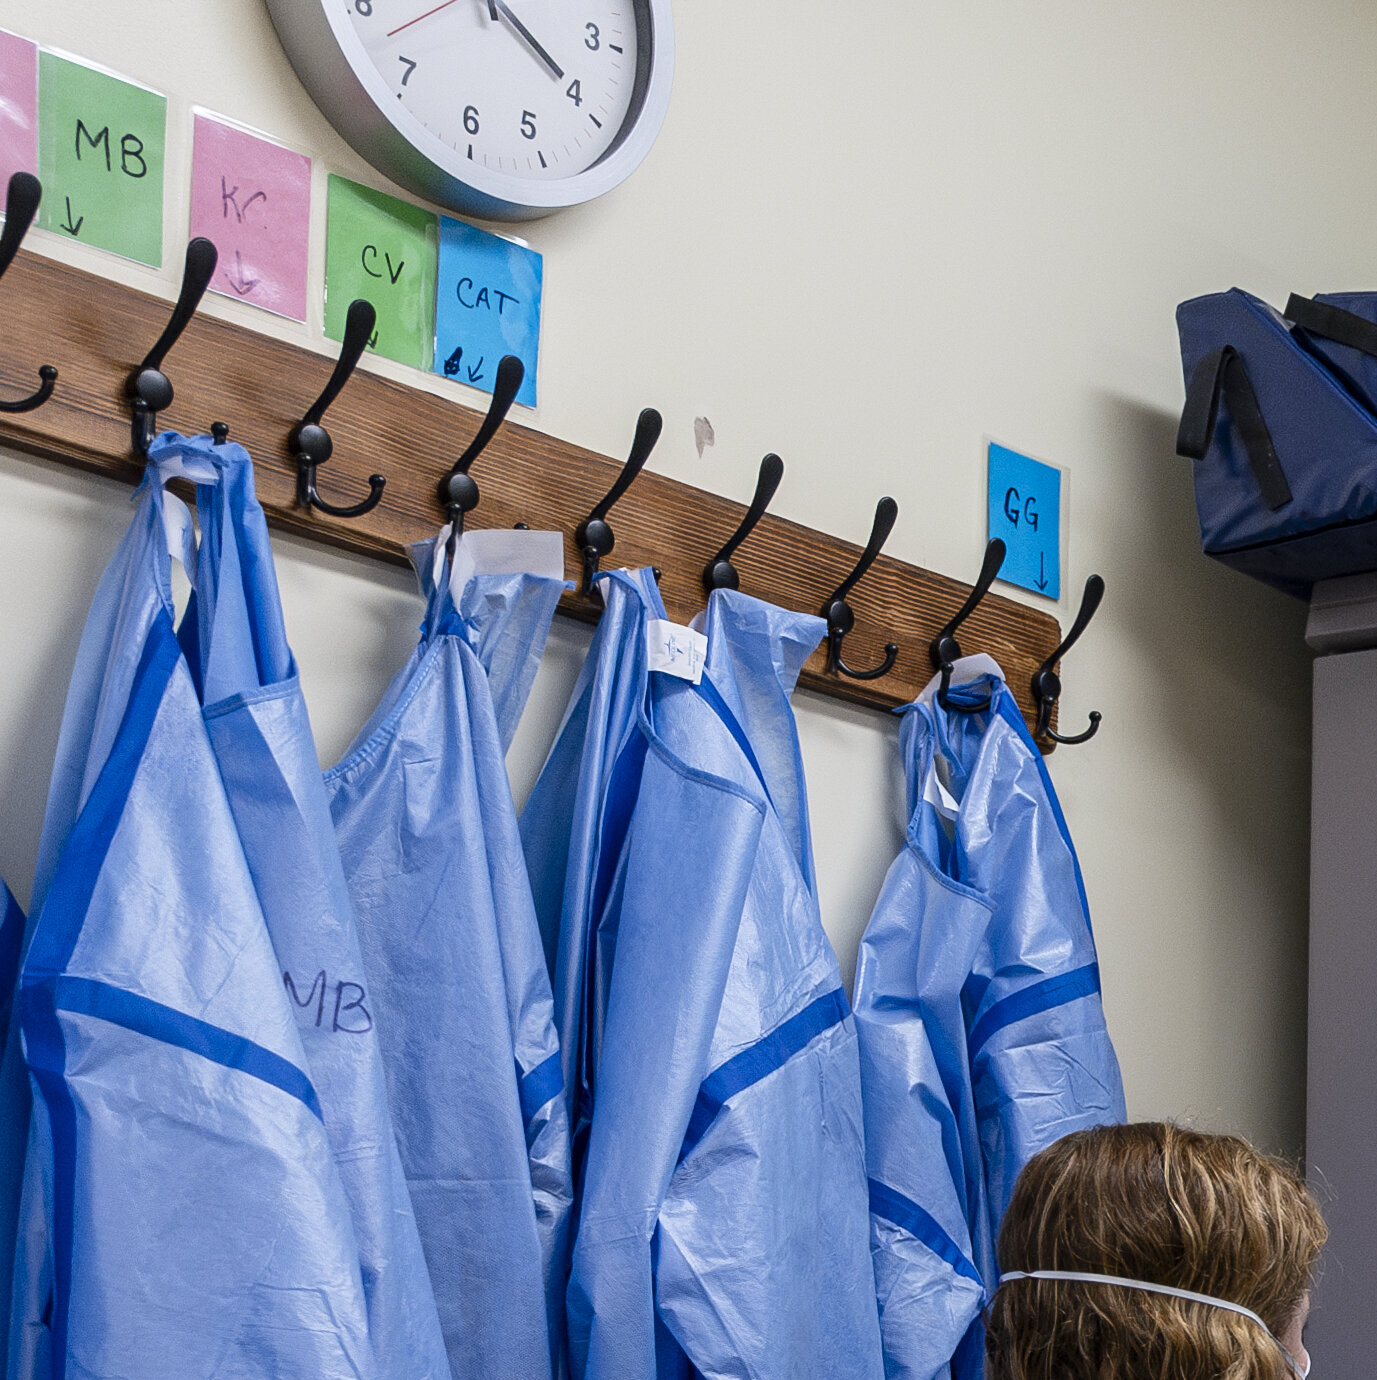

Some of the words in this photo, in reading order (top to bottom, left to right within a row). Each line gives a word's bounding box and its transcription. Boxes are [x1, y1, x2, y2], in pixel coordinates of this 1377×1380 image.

[584, 22, 600, 51] 3
[399, 55, 417, 87] 7
[566, 79, 583, 107] 4
[463, 105, 480, 135] 6
[520, 110, 537, 140] 5
[75, 119, 147, 179] MB
[361, 245, 405, 285] CV
[456, 277, 520, 315] CAT
[283, 969, 373, 1034] MB
